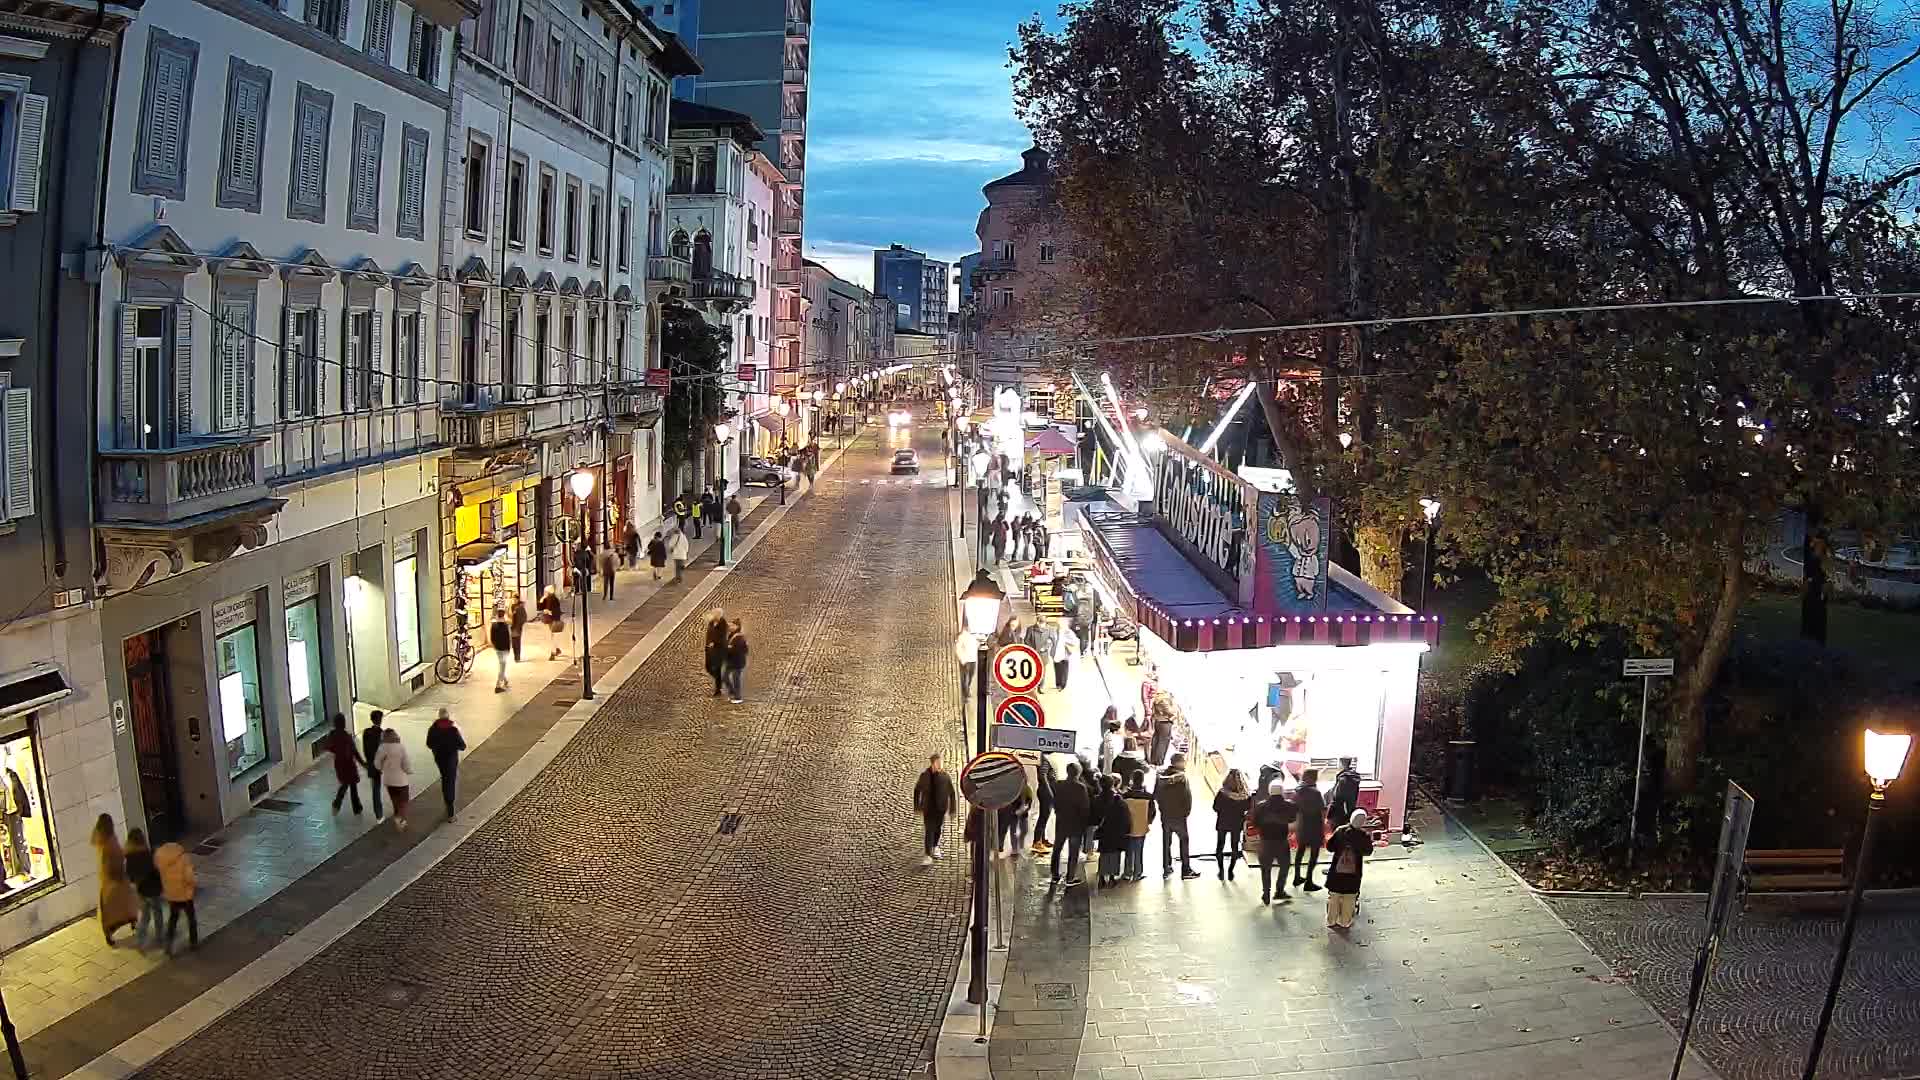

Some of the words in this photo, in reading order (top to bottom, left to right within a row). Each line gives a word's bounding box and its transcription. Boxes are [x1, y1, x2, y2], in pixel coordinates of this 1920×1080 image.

[1162, 454, 1233, 570] Golosone
[1005, 658, 1033, 680] 30
[1038, 737, 1070, 748] Dante
